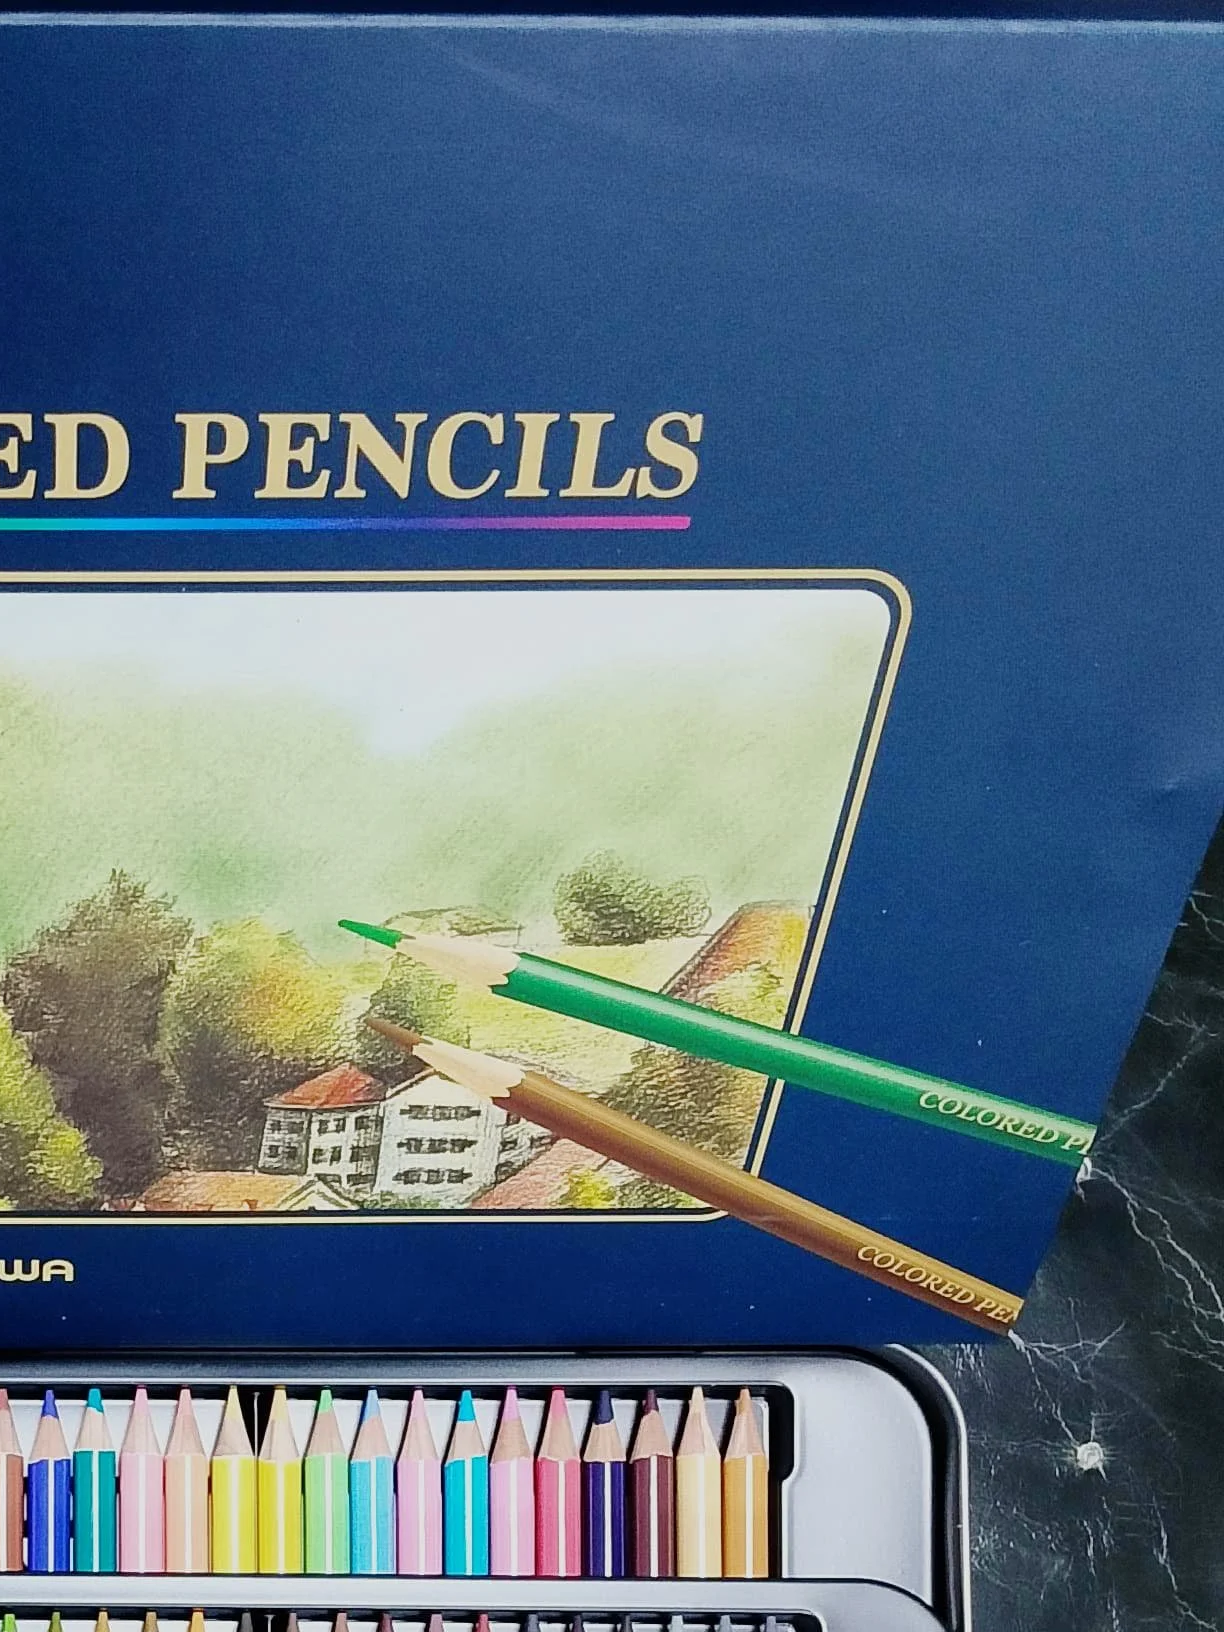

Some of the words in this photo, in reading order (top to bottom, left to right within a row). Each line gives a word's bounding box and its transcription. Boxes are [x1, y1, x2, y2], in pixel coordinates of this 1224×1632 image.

[174, 409, 706, 502] PENCILS
[919, 1091, 1060, 1143] COLORED
[857, 1246, 976, 1304] COLORED
